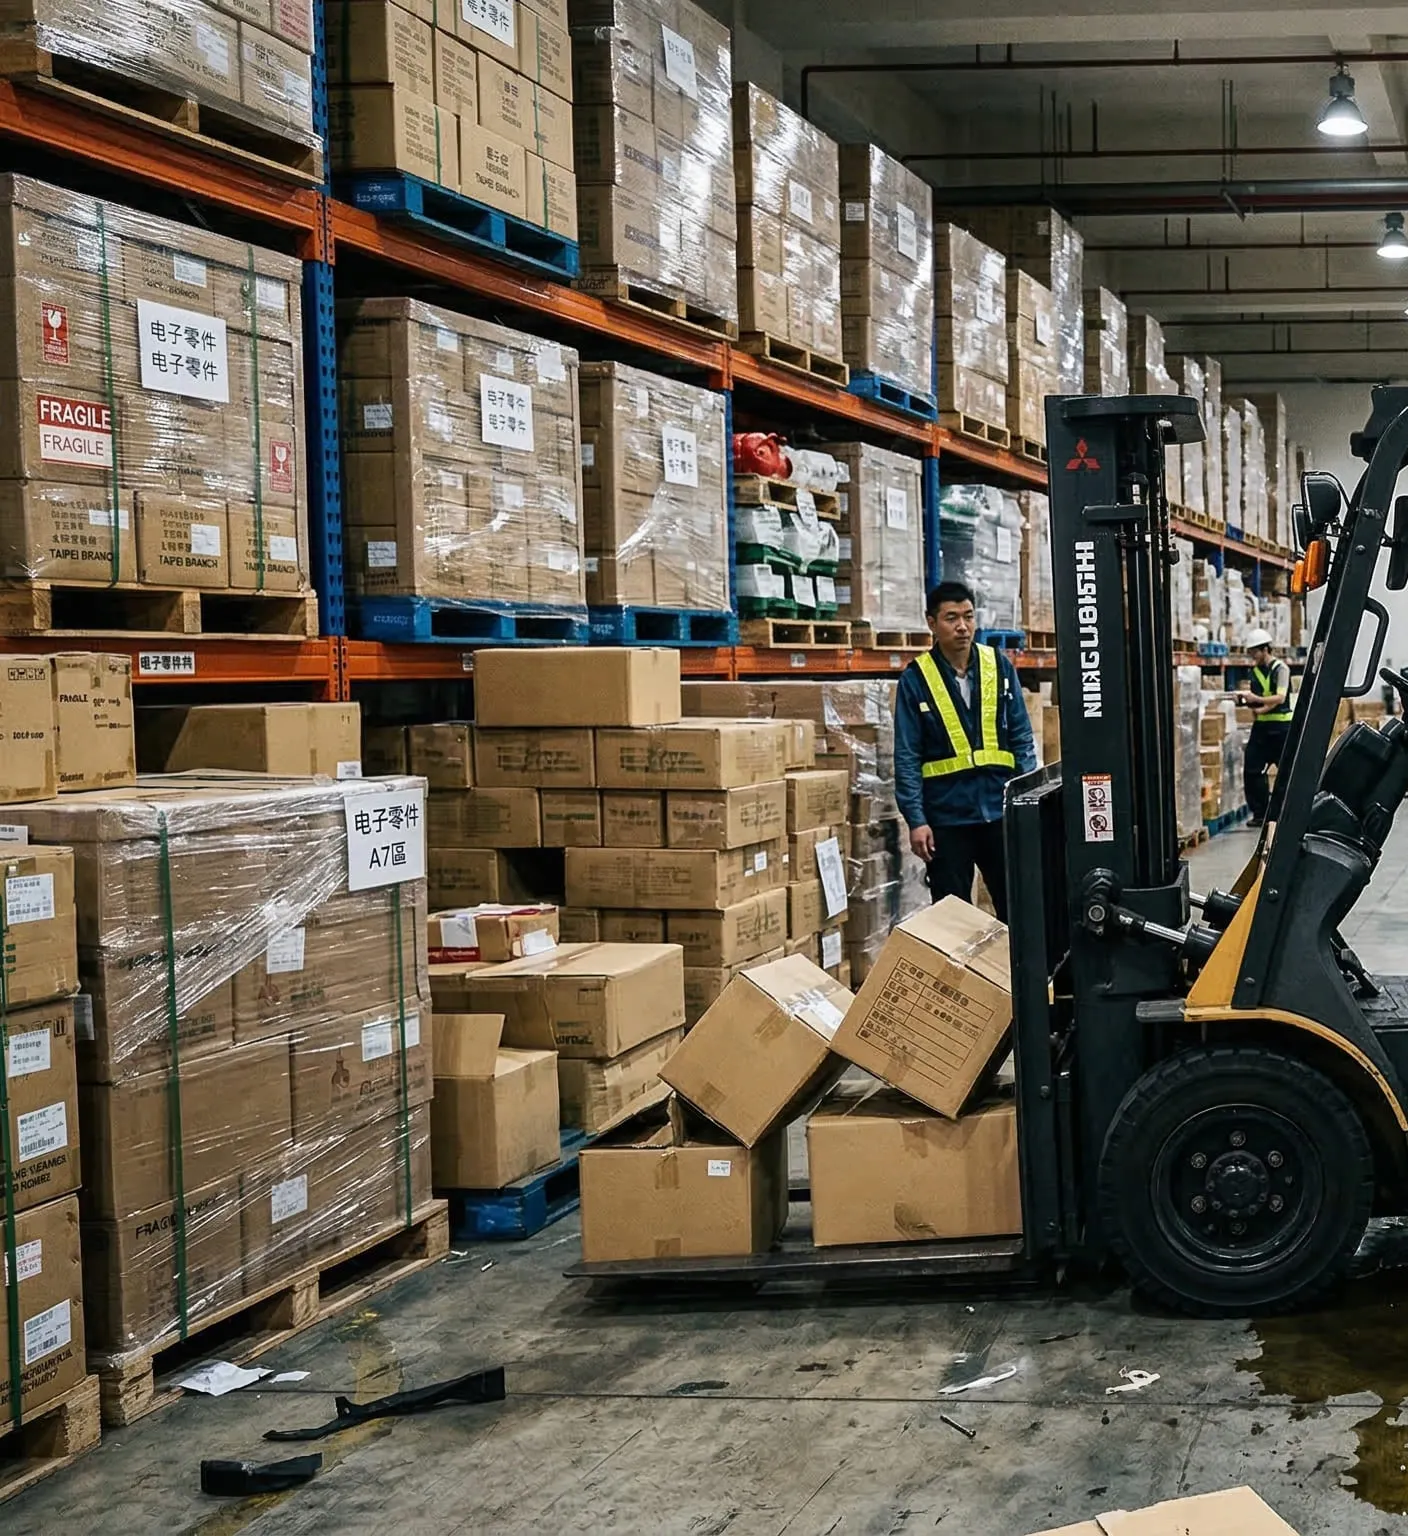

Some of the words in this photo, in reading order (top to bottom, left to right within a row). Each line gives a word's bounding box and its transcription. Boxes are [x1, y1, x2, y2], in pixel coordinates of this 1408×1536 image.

[150, 319, 217, 353] 电子零件
[152, 350, 219, 382] 电子零件
[40, 399, 111, 430] FRAGILE
[43, 434, 104, 457] FRAGILE
[50, 548, 79, 560] TAIPEI
[354, 803, 419, 836] 电子零件
[369, 841, 407, 870] A7區
